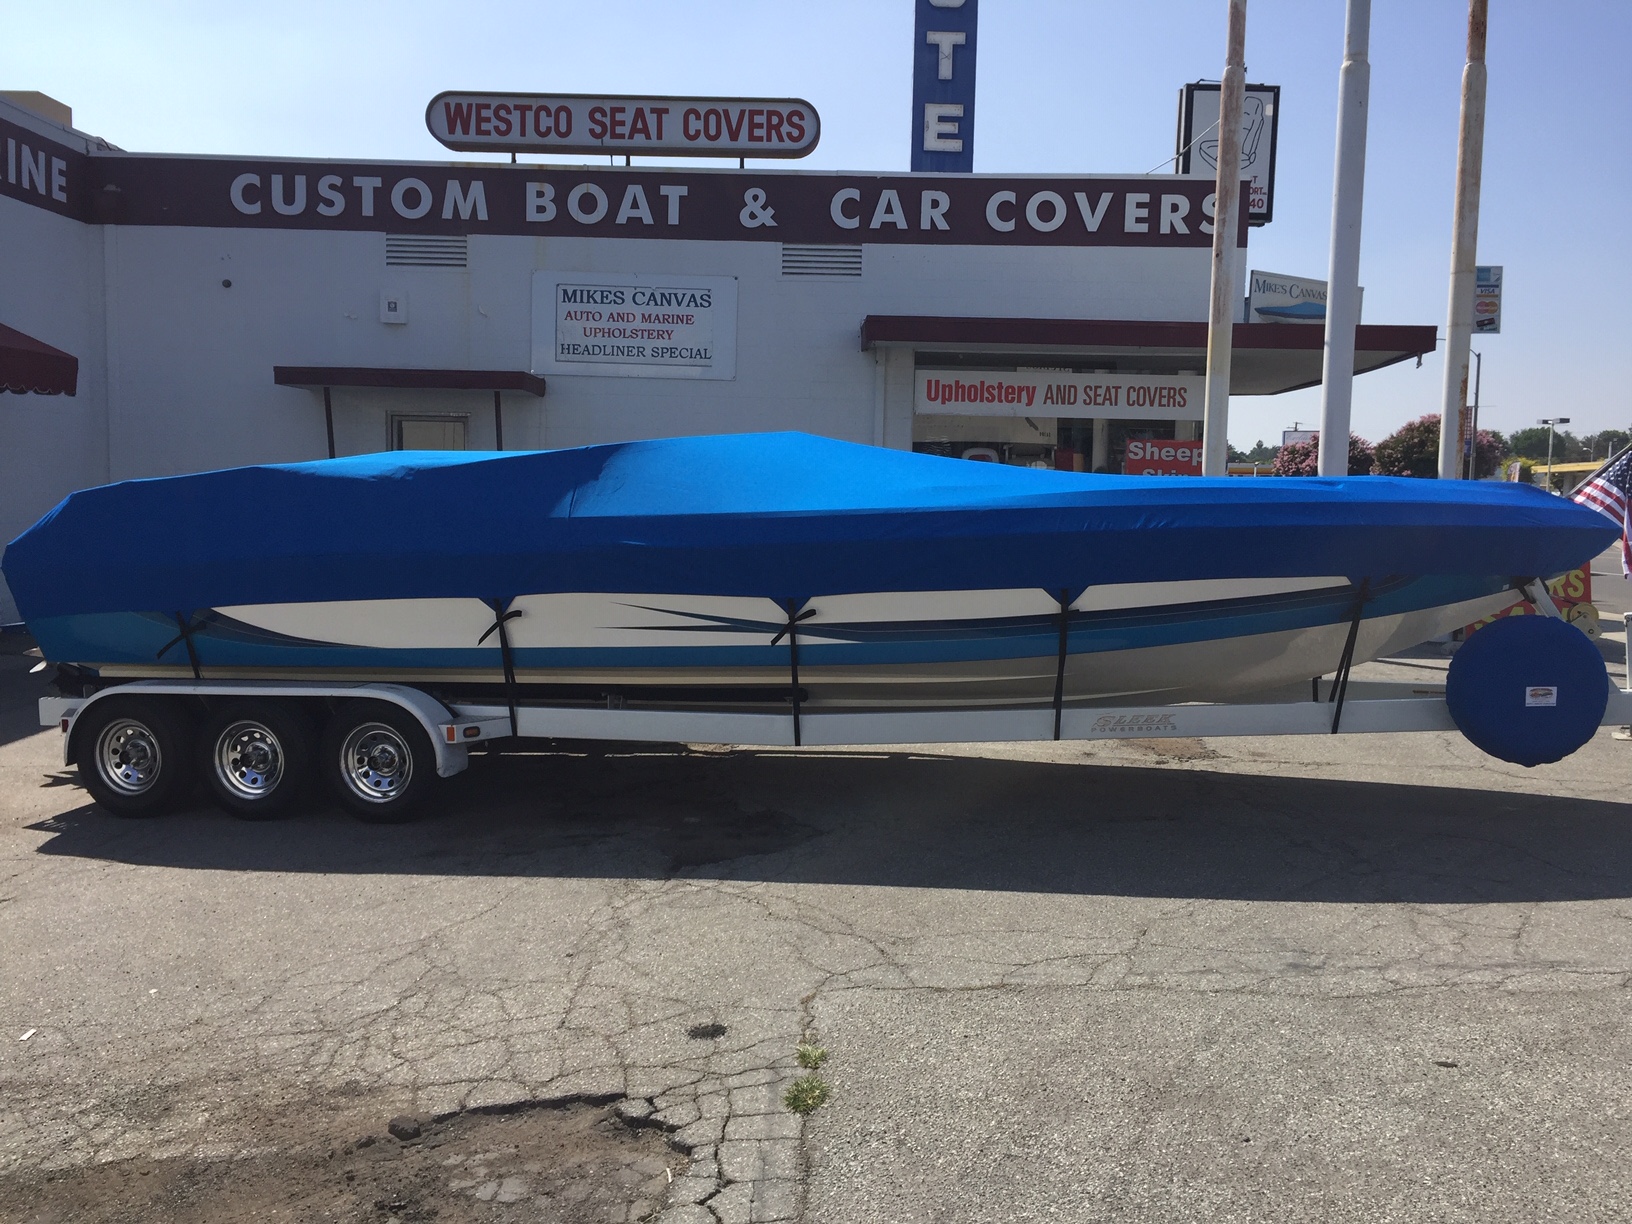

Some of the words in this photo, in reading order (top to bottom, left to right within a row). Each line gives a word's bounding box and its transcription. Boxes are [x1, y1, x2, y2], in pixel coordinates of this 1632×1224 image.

[923, 0, 966, 152] TE
[443, 101, 573, 139] WESTCO
[588, 106, 670, 141] SEAT
[683, 107, 806, 143] COVERS
[0, 137, 67, 203] INE
[229, 172, 489, 221] CUSTOM
[525, 181, 689, 225] BOAT
[739, 187, 778, 228] &
[829, 187, 951, 231] CAR
[561, 288, 626, 305] MIKES
[632, 291, 712, 308] CANVAS
[564, 310, 602, 322] AUTO
[606, 312, 636, 323] AND
[641, 313, 695, 325] MARINE
[583, 327, 675, 340] UPHOLSTERY
[560, 343, 646, 358] HEADLINER
[651, 346, 712, 360] SPECIAL
[926, 379, 1037, 407] Upholstery
[1043, 384, 1078, 405] AND
[1083, 384, 1122, 406] SEAT
[1126, 385, 1187, 408] COVERS
[1128, 441, 1203, 466] Sheep
[1092, 713, 1176, 728] SLEEK
